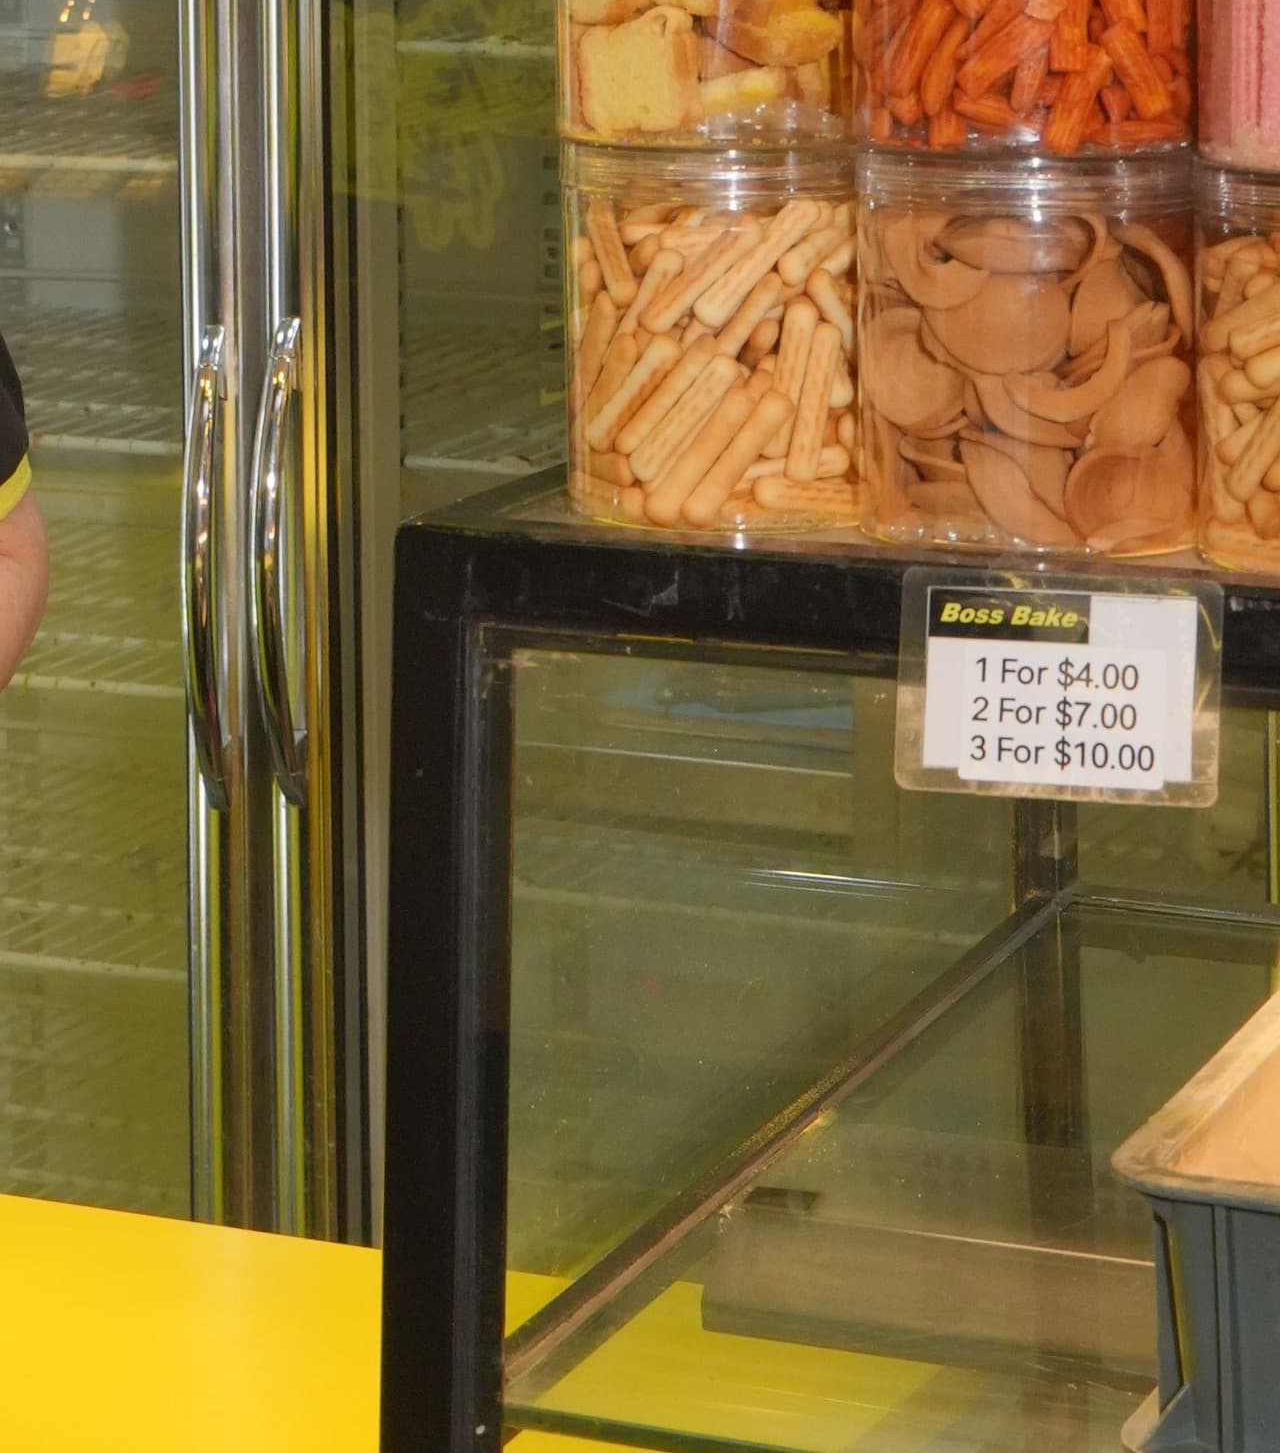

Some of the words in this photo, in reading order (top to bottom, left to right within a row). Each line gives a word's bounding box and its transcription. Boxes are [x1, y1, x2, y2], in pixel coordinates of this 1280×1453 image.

[940, 602, 1004, 624] Boss
[1010, 605, 1079, 629] Bake
[975, 657, 988, 682] 1
[1000, 658, 1048, 686] For
[1056, 657, 1140, 691] $4.00
[971, 697, 989, 722] 2
[998, 698, 1046, 725] For
[1055, 696, 1138, 731] $7.00
[969, 735, 987, 761] 3
[997, 737, 1045, 764] For
[1053, 736, 1155, 772] $10.00
